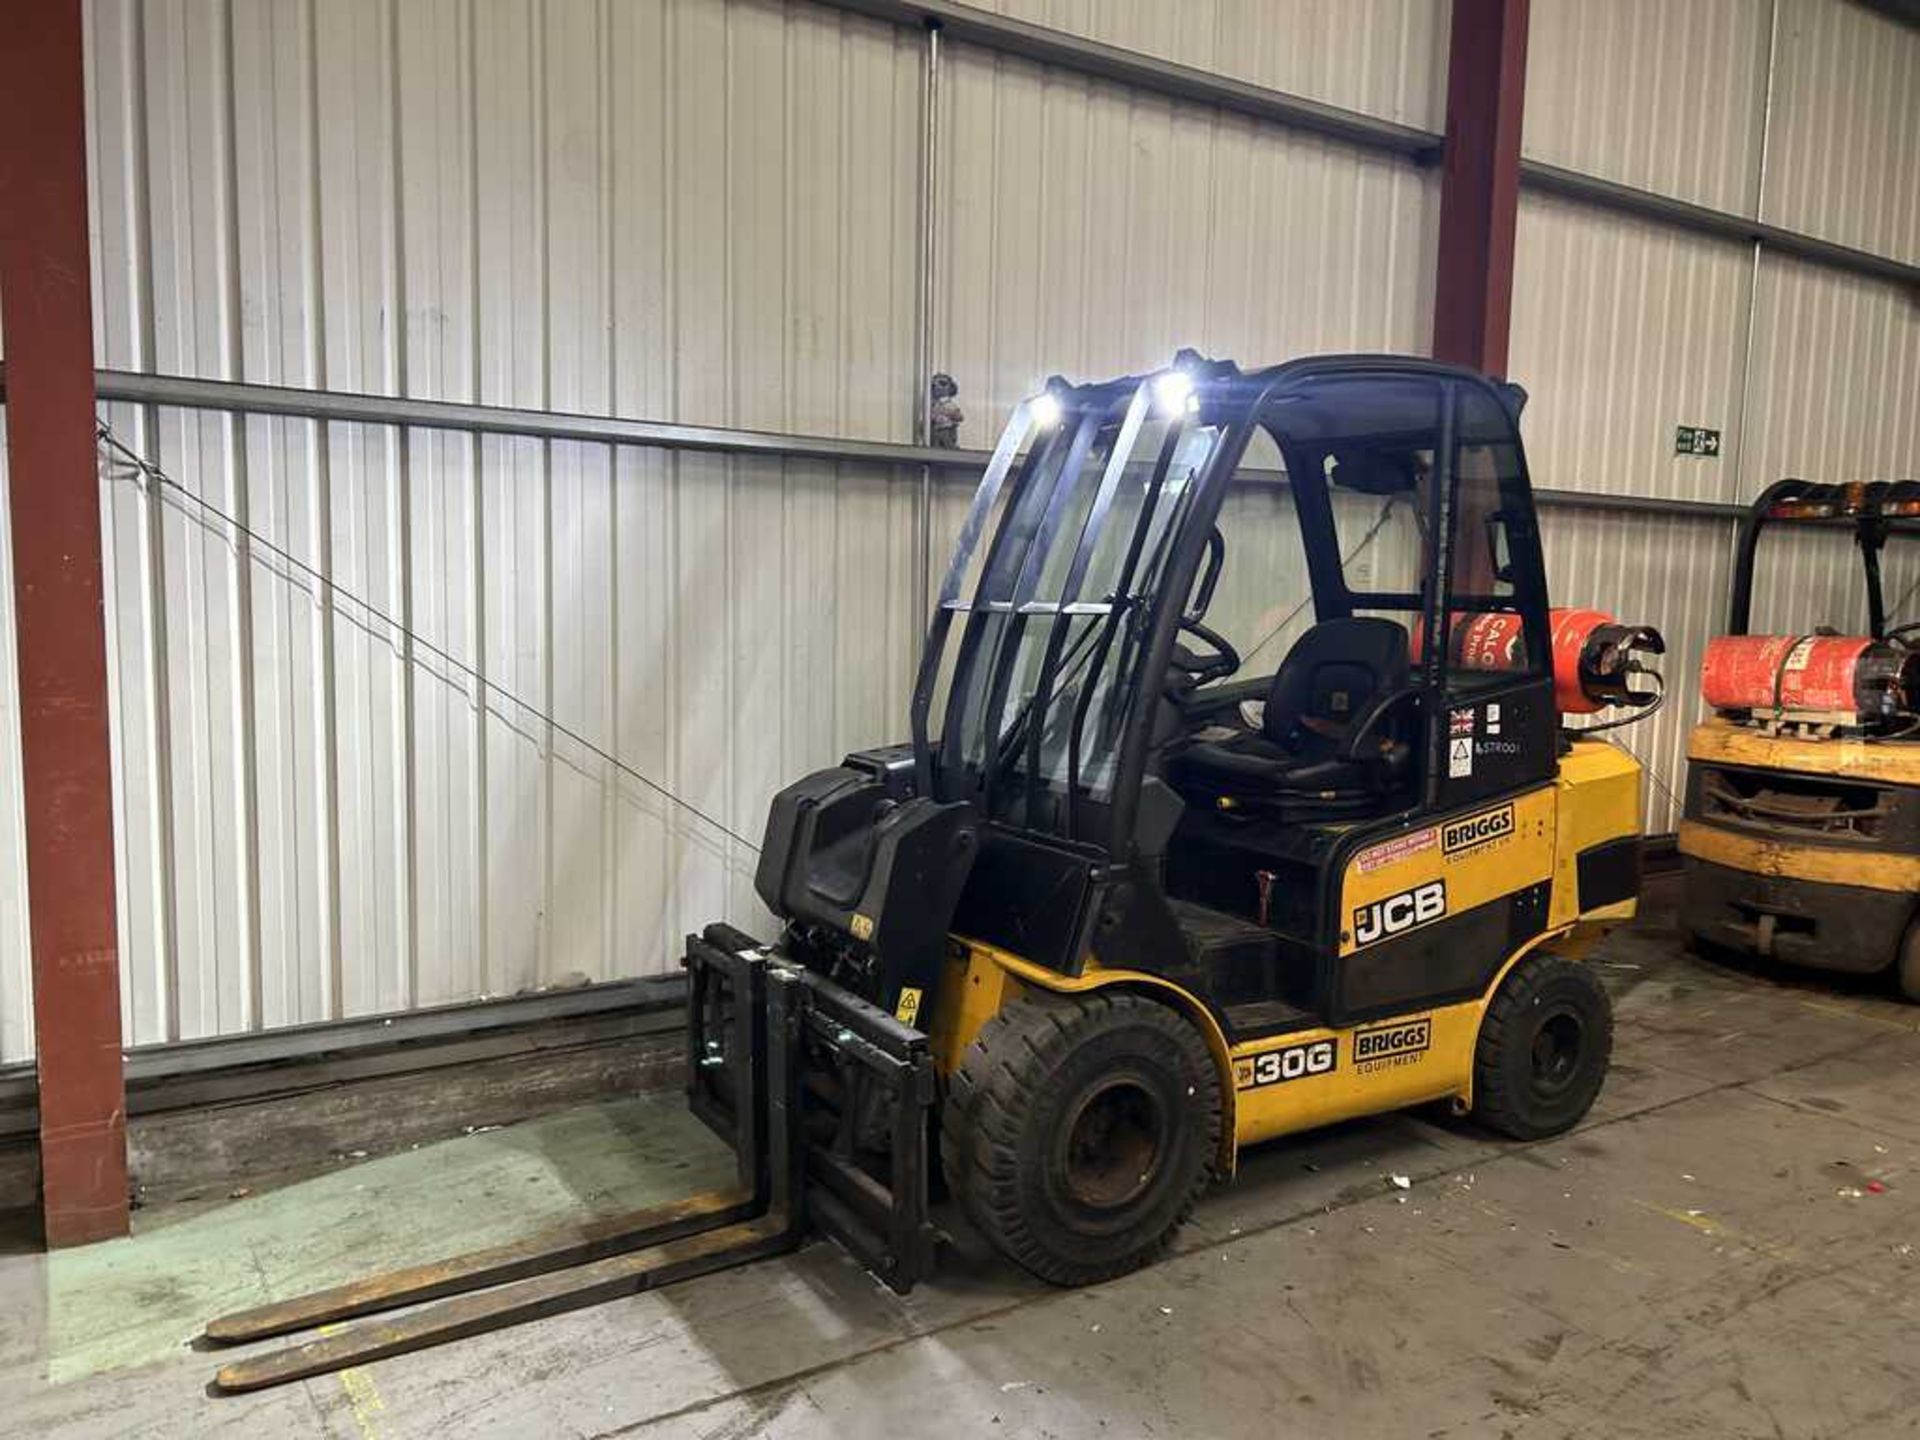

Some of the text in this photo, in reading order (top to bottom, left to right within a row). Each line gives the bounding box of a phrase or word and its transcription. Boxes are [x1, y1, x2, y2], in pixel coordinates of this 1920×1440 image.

[1483, 619, 1507, 665] CALO
[1446, 810, 1510, 849] BRIGGS
[1356, 882, 1444, 943] JCB
[1358, 1026, 1425, 1055] BRIGGS
[1255, 1042, 1333, 1085] 30G
[1356, 1054, 1423, 1075] EQUIPMENT
